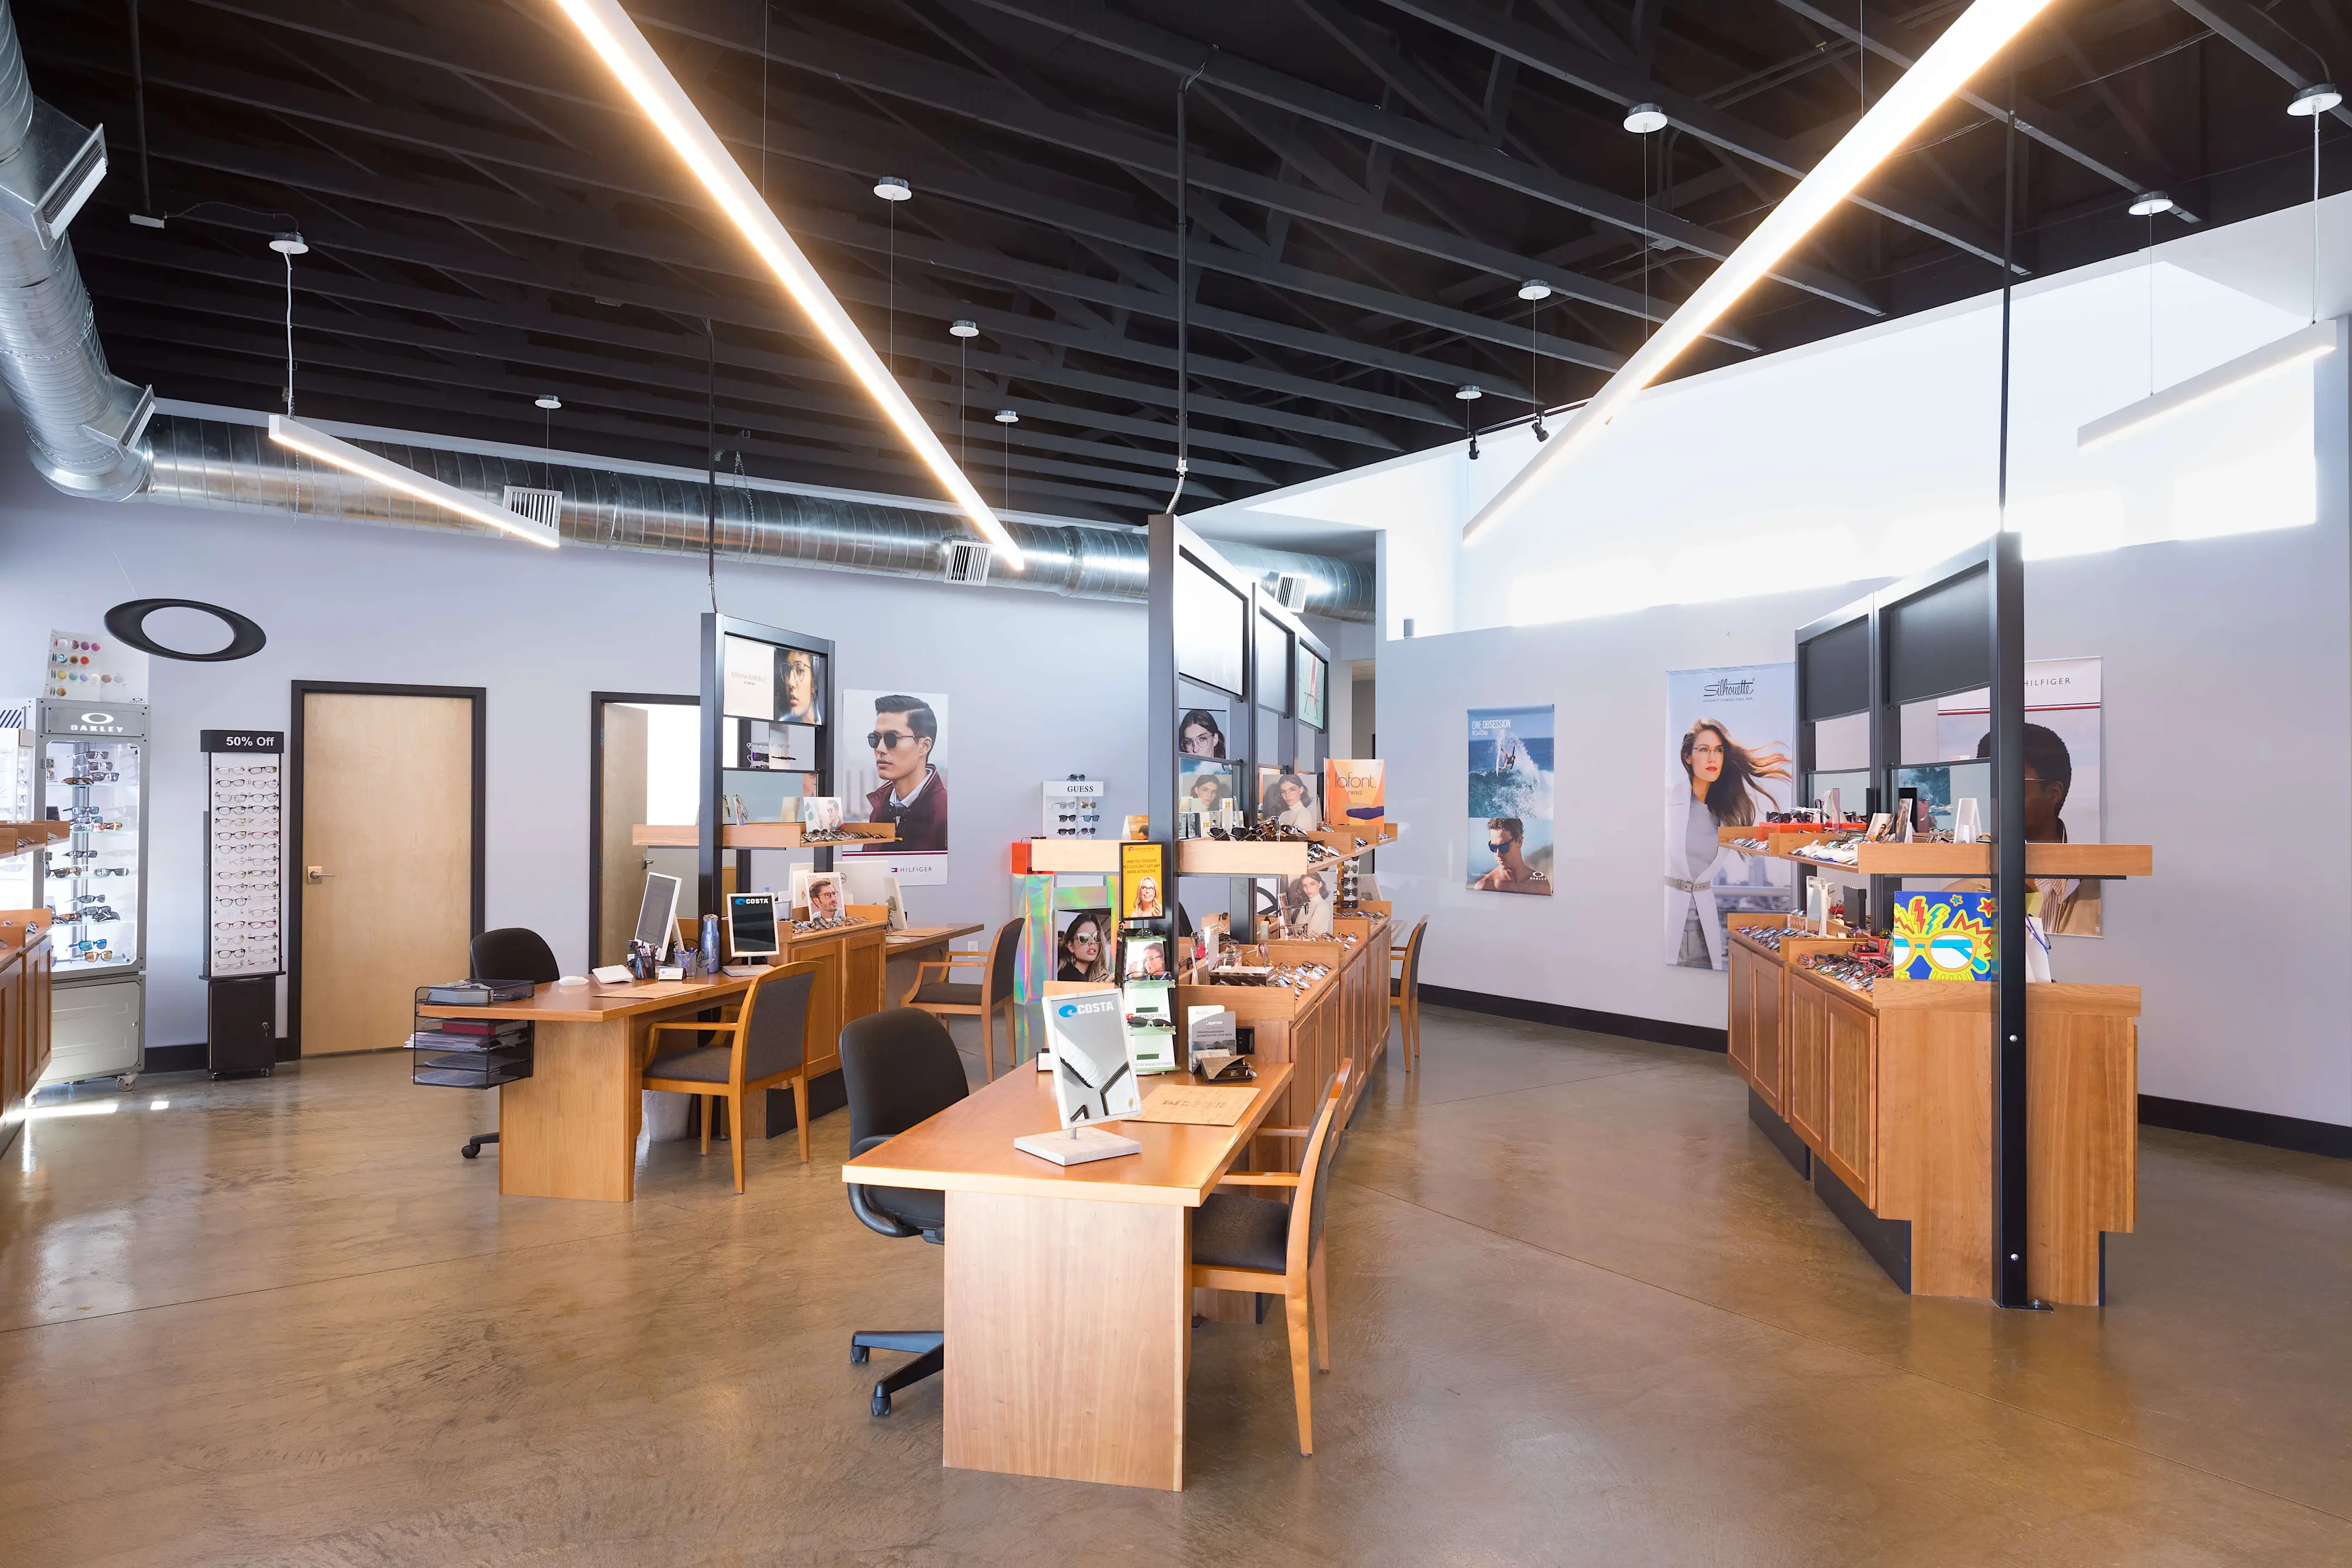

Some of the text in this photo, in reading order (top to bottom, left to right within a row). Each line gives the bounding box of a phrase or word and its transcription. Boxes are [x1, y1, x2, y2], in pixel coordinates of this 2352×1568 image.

[1703, 678, 1753, 696] Silhouette
[2023, 678, 2070, 686] HILFIGER
[71, 724, 123, 733] OAKLEY
[1472, 719, 1511, 730] ONE OBSESSION
[226, 736, 275, 746] 50% Off
[1077, 1001, 1114, 1014] COSTA
